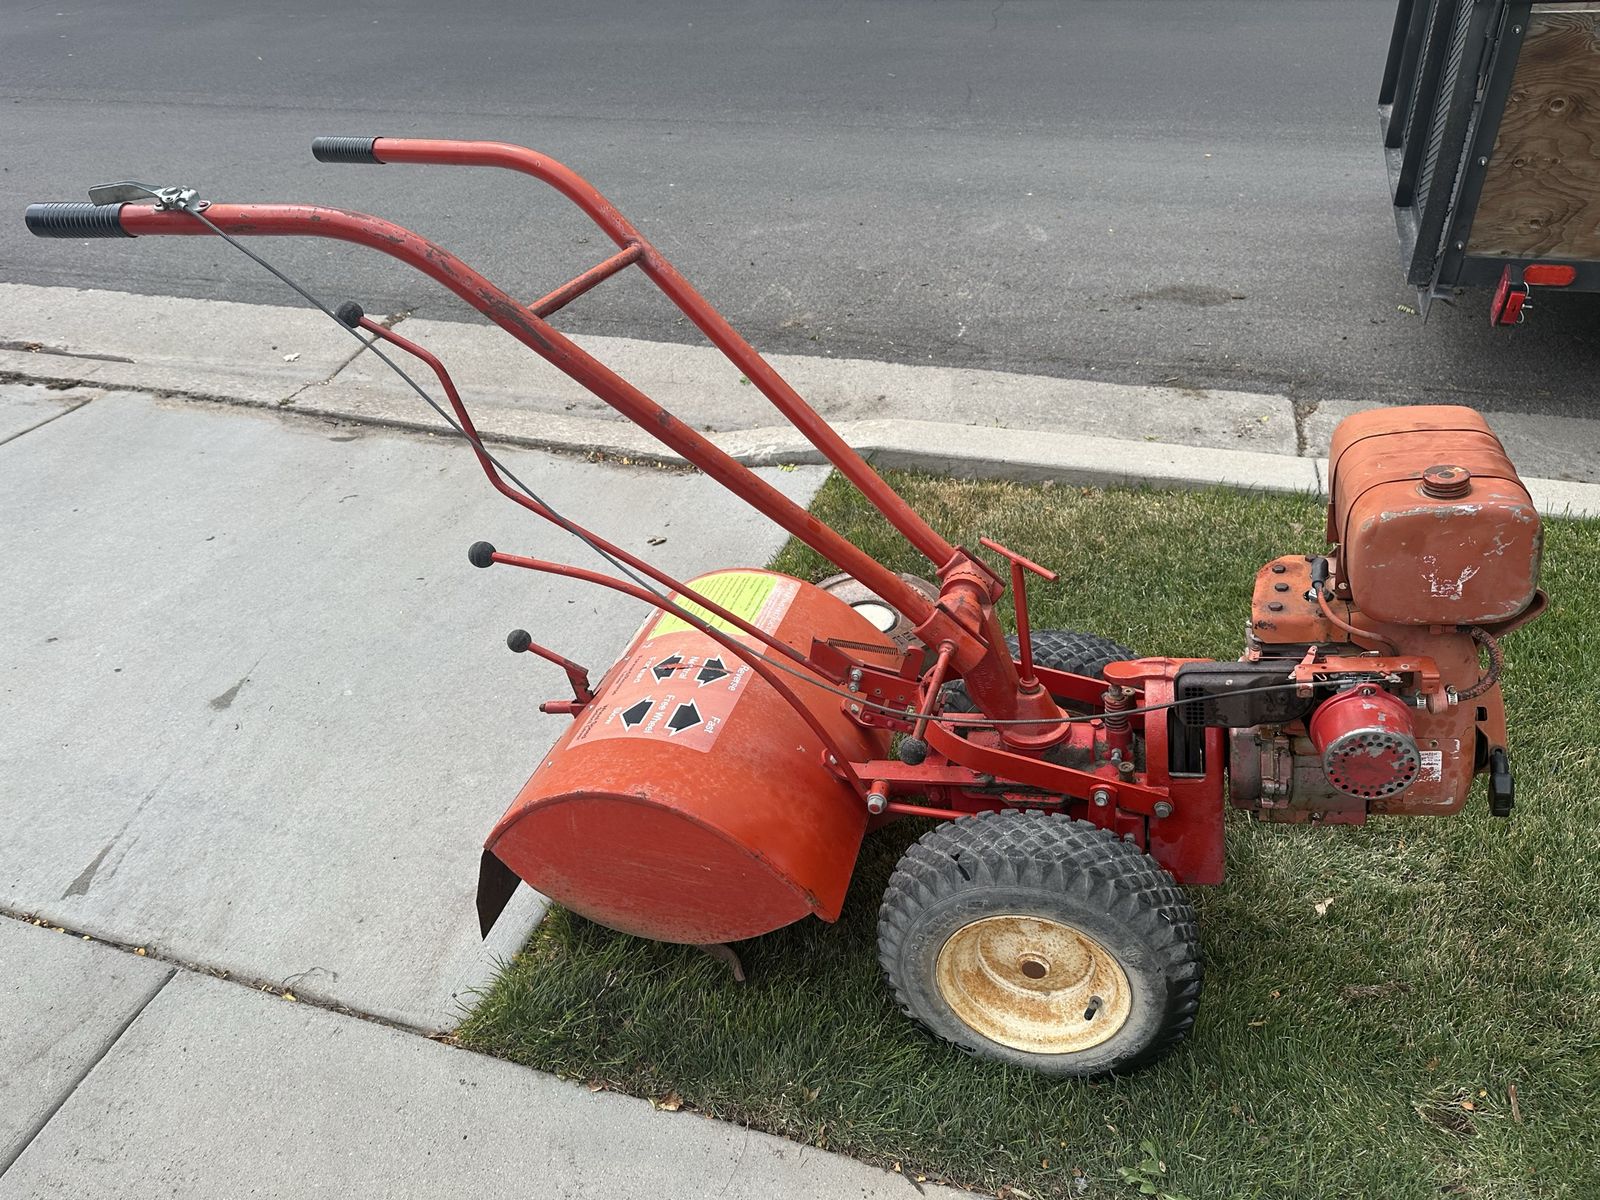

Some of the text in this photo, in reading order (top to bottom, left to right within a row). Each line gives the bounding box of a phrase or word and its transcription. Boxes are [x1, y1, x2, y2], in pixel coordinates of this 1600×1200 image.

[728, 664, 749, 691] Reverse
[643, 694, 675, 734] Free Wheel
[704, 716, 721, 733] Fast
